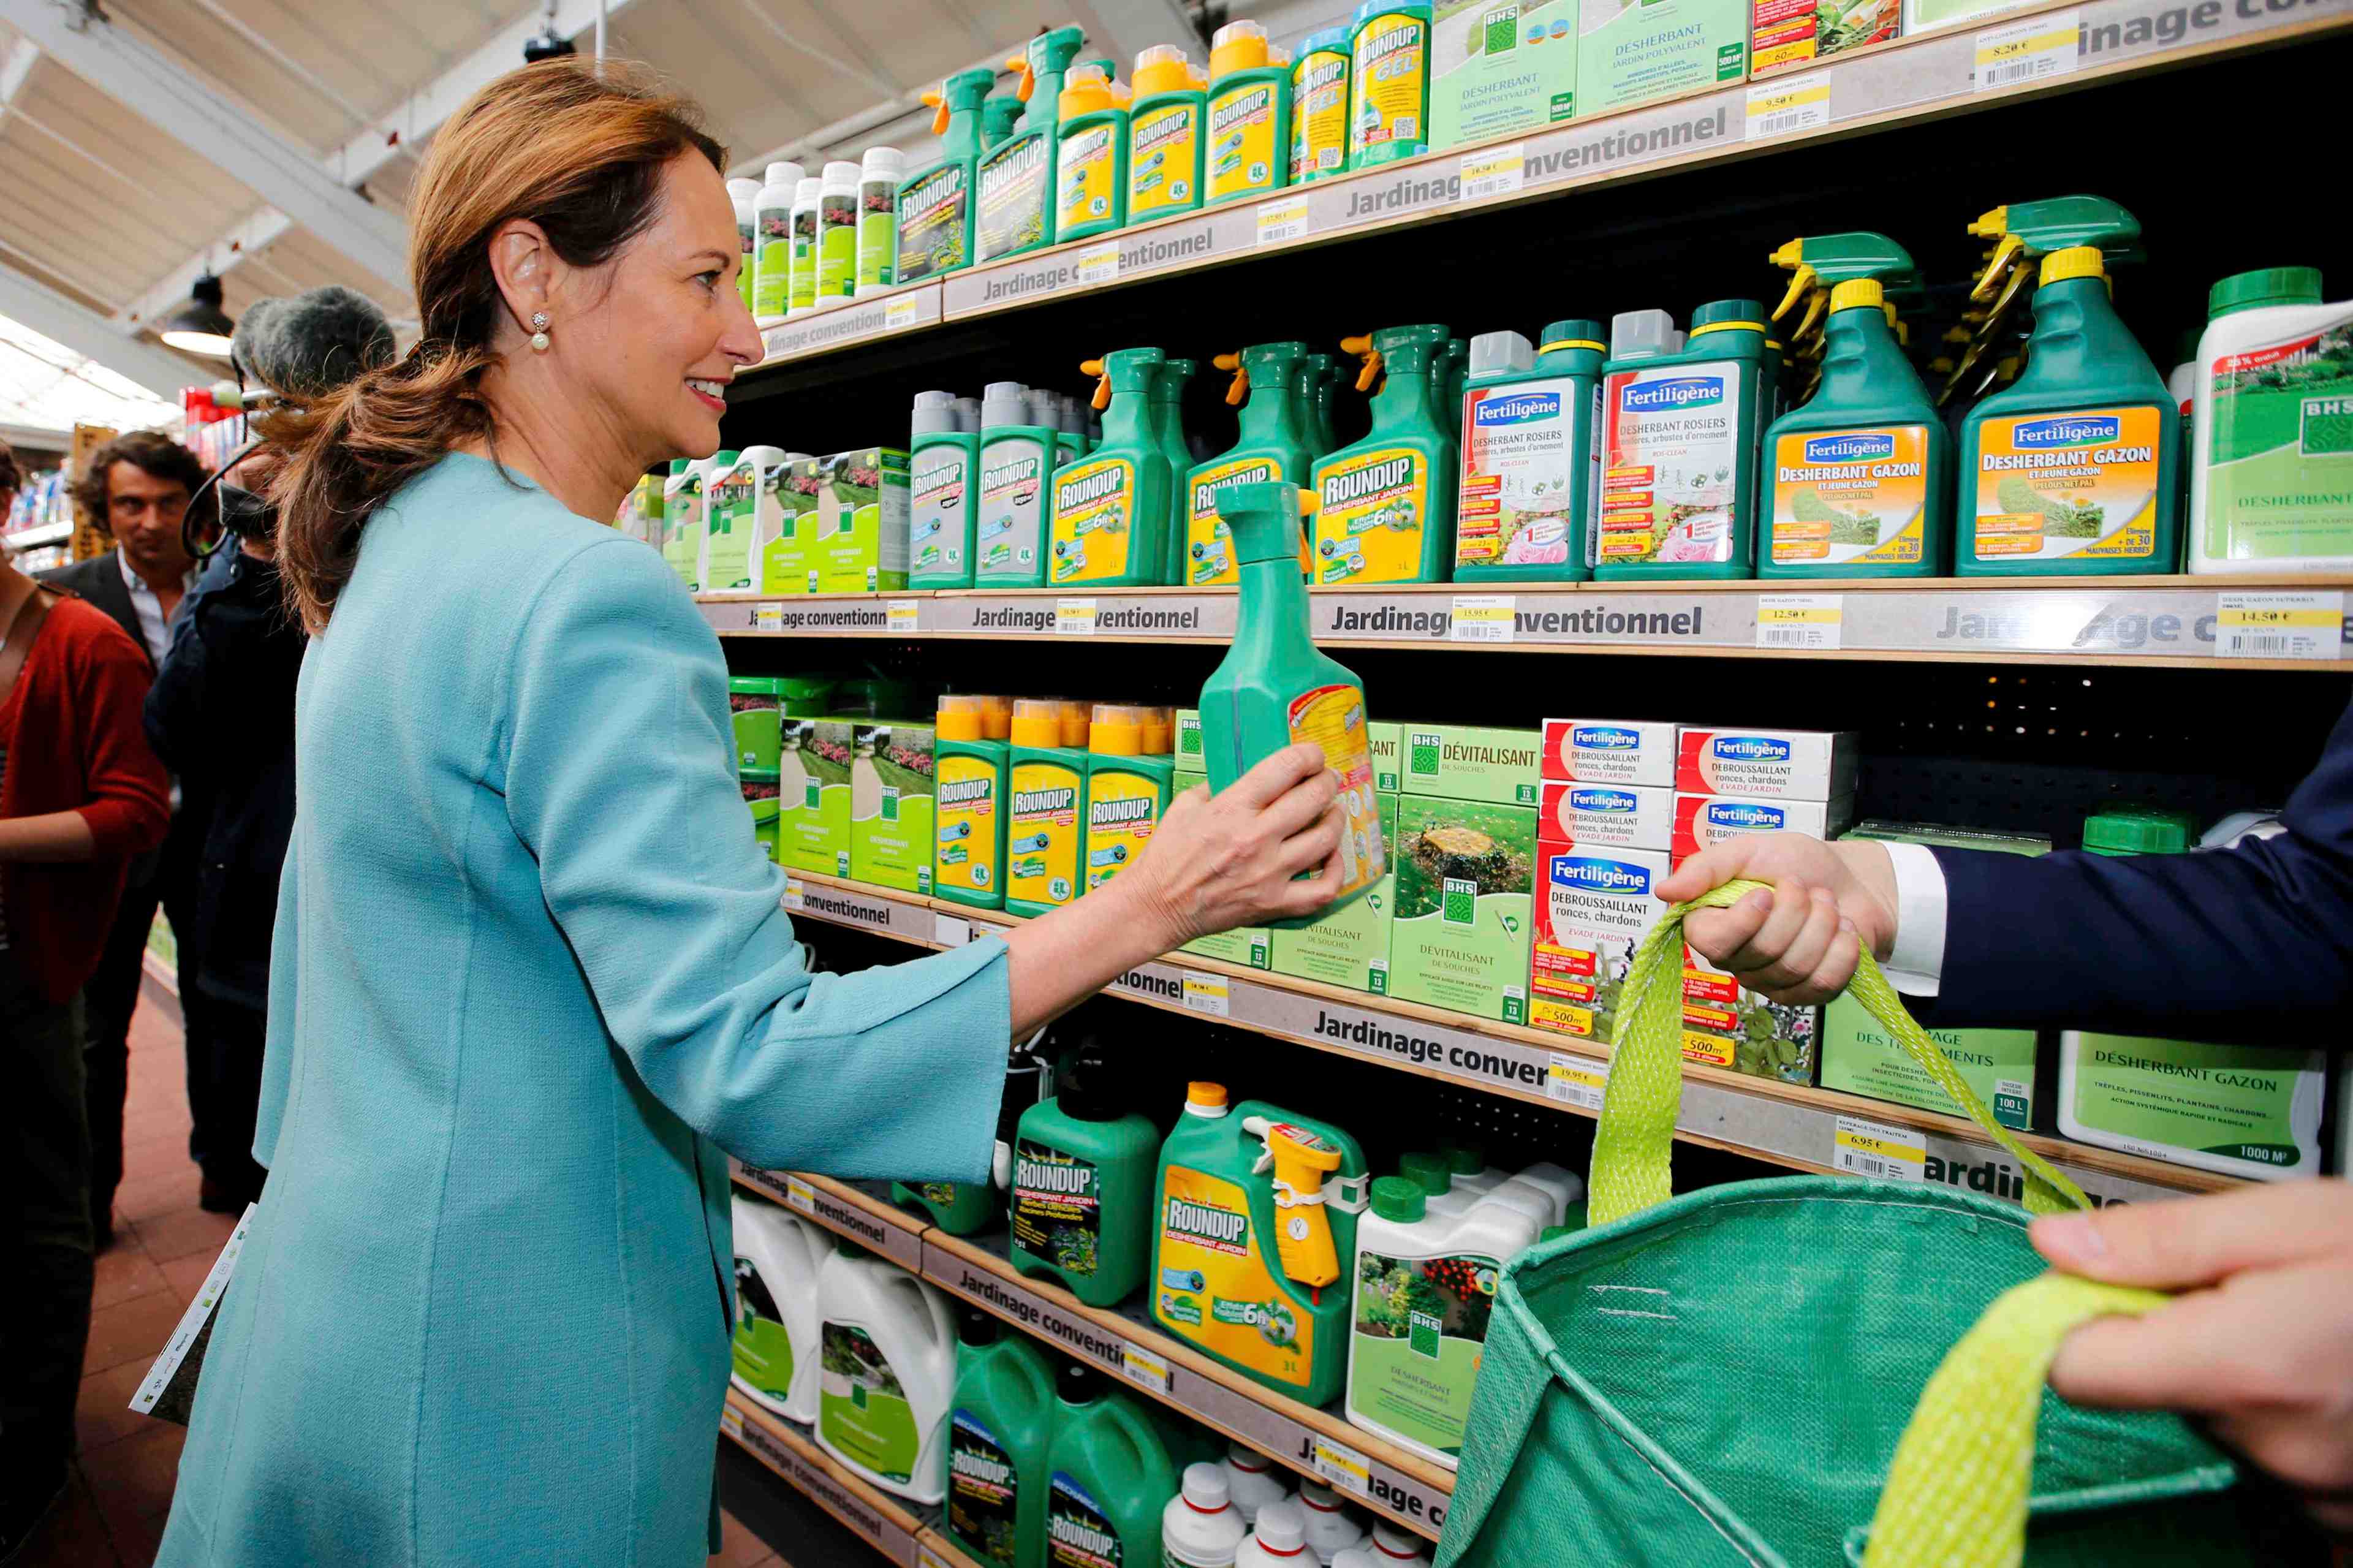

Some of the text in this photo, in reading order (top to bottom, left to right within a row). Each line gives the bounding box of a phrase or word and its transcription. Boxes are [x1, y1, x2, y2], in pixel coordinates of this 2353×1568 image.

[1488, 9, 1516, 25] BHS
[2078, 0, 2222, 56] inage
[1646, 37, 1707, 60] POLYVALENT
[1775, 51, 1787, 61] 60
[1993, 40, 2030, 57] 8.20 €
[1376, 56, 1415, 81] GEL
[1214, 89, 1267, 131] ROUNDUP
[1308, 89, 1339, 113] GEL
[1765, 96, 1786, 109] 9.50
[1137, 110, 1187, 150] ROUNDUP
[1524, 107, 1726, 178] nventionnel
[982, 138, 1041, 197] ROUNDUP
[902, 169, 961, 221] ROUNDUP
[983, 260, 1067, 301] Jardinage
[1068, 227, 1213, 282] centionnel
[767, 309, 886, 354] dinage conventionn
[1626, 383, 1719, 407] Fertiligène
[1478, 398, 1558, 422] Fertiligène
[1620, 417, 1726, 436] DESHERBANT ROSIERS
[1653, 430, 1729, 442] arbustes d'ornement
[2017, 423, 2115, 446] Fertiligène
[1473, 430, 1562, 449] DESHERBANT ROSIERS
[1501, 441, 1564, 454] arbustes d'ornement
[1809, 441, 1889, 462] Fertiligène
[1982, 446, 2151, 471] DESHERBANT GAZON
[915, 464, 960, 496] ROUNDUP
[984, 459, 1035, 492] ROUNDUP
[1327, 457, 1410, 505] ROUNDUP
[1779, 463, 1920, 482] DESHERBANT GAZON
[2029, 466, 2101, 478] ET JEUNE GAZON
[1061, 468, 1121, 510] ROUNDUP
[1827, 481, 1851, 490] JEUNE
[1852, 479, 1877, 488] GAZON
[1058, 490, 1124, 520] DESHERBANT JARDIN
[1324, 483, 1414, 516] DESHERBANT JARDIN
[1908, 542, 1919, 552] 30
[2138, 536, 2150, 547] 30
[807, 608, 886, 627] conventionn
[972, 607, 1056, 631] Jardinage
[1095, 605, 1199, 629] ventionnel
[1463, 608, 1483, 618] 15.95
[1515, 605, 1702, 635] nventionnel
[1773, 610, 1799, 619] 12.50
[2241, 612, 2292, 623] 14.50 €
[1575, 730, 1637, 748] Fertiligène
[1414, 735, 1536, 767] BHS DÉVITALISANT
[1571, 751, 1640, 763] DEBROUSSAILLANT
[1716, 740, 1787, 759] Fertiligène
[1453, 765, 1485, 774] SOUCHES
[1575, 762, 1637, 773] ronces, chardons
[1579, 770, 1632, 780] EVADE JARDIN
[1711, 762, 1791, 776] DEBROUSSAILLANT
[805, 778, 820, 788] BHS
[1716, 773, 1787, 786] ronces, chardons
[1721, 783, 1782, 794] EVADE JARDIN
[882, 787, 898, 798] BHS
[941, 780, 988, 803] ROUNDUP
[1573, 792, 1634, 810] Fertiligène
[1015, 789, 1072, 814] ROUNDUP
[1014, 808, 1074, 821] DESHERBANT JARDIN
[1093, 798, 1150, 825] ROUNDUP
[1569, 812, 1639, 825] DEBROUSSAILLANT
[1711, 806, 1781, 826] Fertiligène
[1091, 819, 1153, 832] DESHERBANT JARDIN
[1572, 824, 1634, 835] ronces, chardons
[1577, 831, 1630, 843] EVADE JARDIN
[1555, 860, 1646, 888] Fertiligène
[1447, 881, 1474, 895] BHS
[802, 893, 890, 925] onventionnel
[1552, 892, 1648, 915] DEBROUSSAILLANT
[1556, 907, 1642, 928] ronces, chardons
[1569, 928, 1626, 943] EVADE JARDIN
[1442, 960, 1480, 975] SOUCHES
[1553, 1010, 1573, 1023] 500
[1314, 1010, 1442, 1062] Jardinage
[1857, 1031, 1883, 1047] DES
[1689, 1039, 1713, 1054] 500
[1561, 1069, 1583, 1081] 19.95
[1872, 1067, 1922, 1083] INSECTICIDES,
[1881, 1062, 1899, 1070] POUR
[2095, 1049, 2277, 1093] DÉSHERBANT GAZON
[1999, 1097, 2017, 1109] 100
[2110, 1096, 2135, 1106] ACTION
[2180, 1110, 2205, 1120] RAPIDE
[2129, 1088, 2222, 1112] PISSENLITS, PLANTAINS,
[1839, 1119, 1870, 1131] REPERAGE
[1882, 1129, 1908, 1139] TRAITEM
[1851, 1135, 1882, 1149] 6.95 €
[2240, 1144, 2287, 1164] 1000 M²
[1017, 1158, 1091, 1194] ROUNDUP
[1063, 1194, 1093, 1206] JARDIN
[814, 1198, 885, 1244] nventionnel
[1170, 1199, 1246, 1244] ROUNDUP
[1166, 1230, 1248, 1256] DESHERBANT JARDIN
[960, 1270, 1039, 1325] Jardinage
[1413, 1314, 1439, 1331] BHS
[953, 1449, 1010, 1485] ROUNDUP
[1052, 1514, 1114, 1558] ROUNDUP
